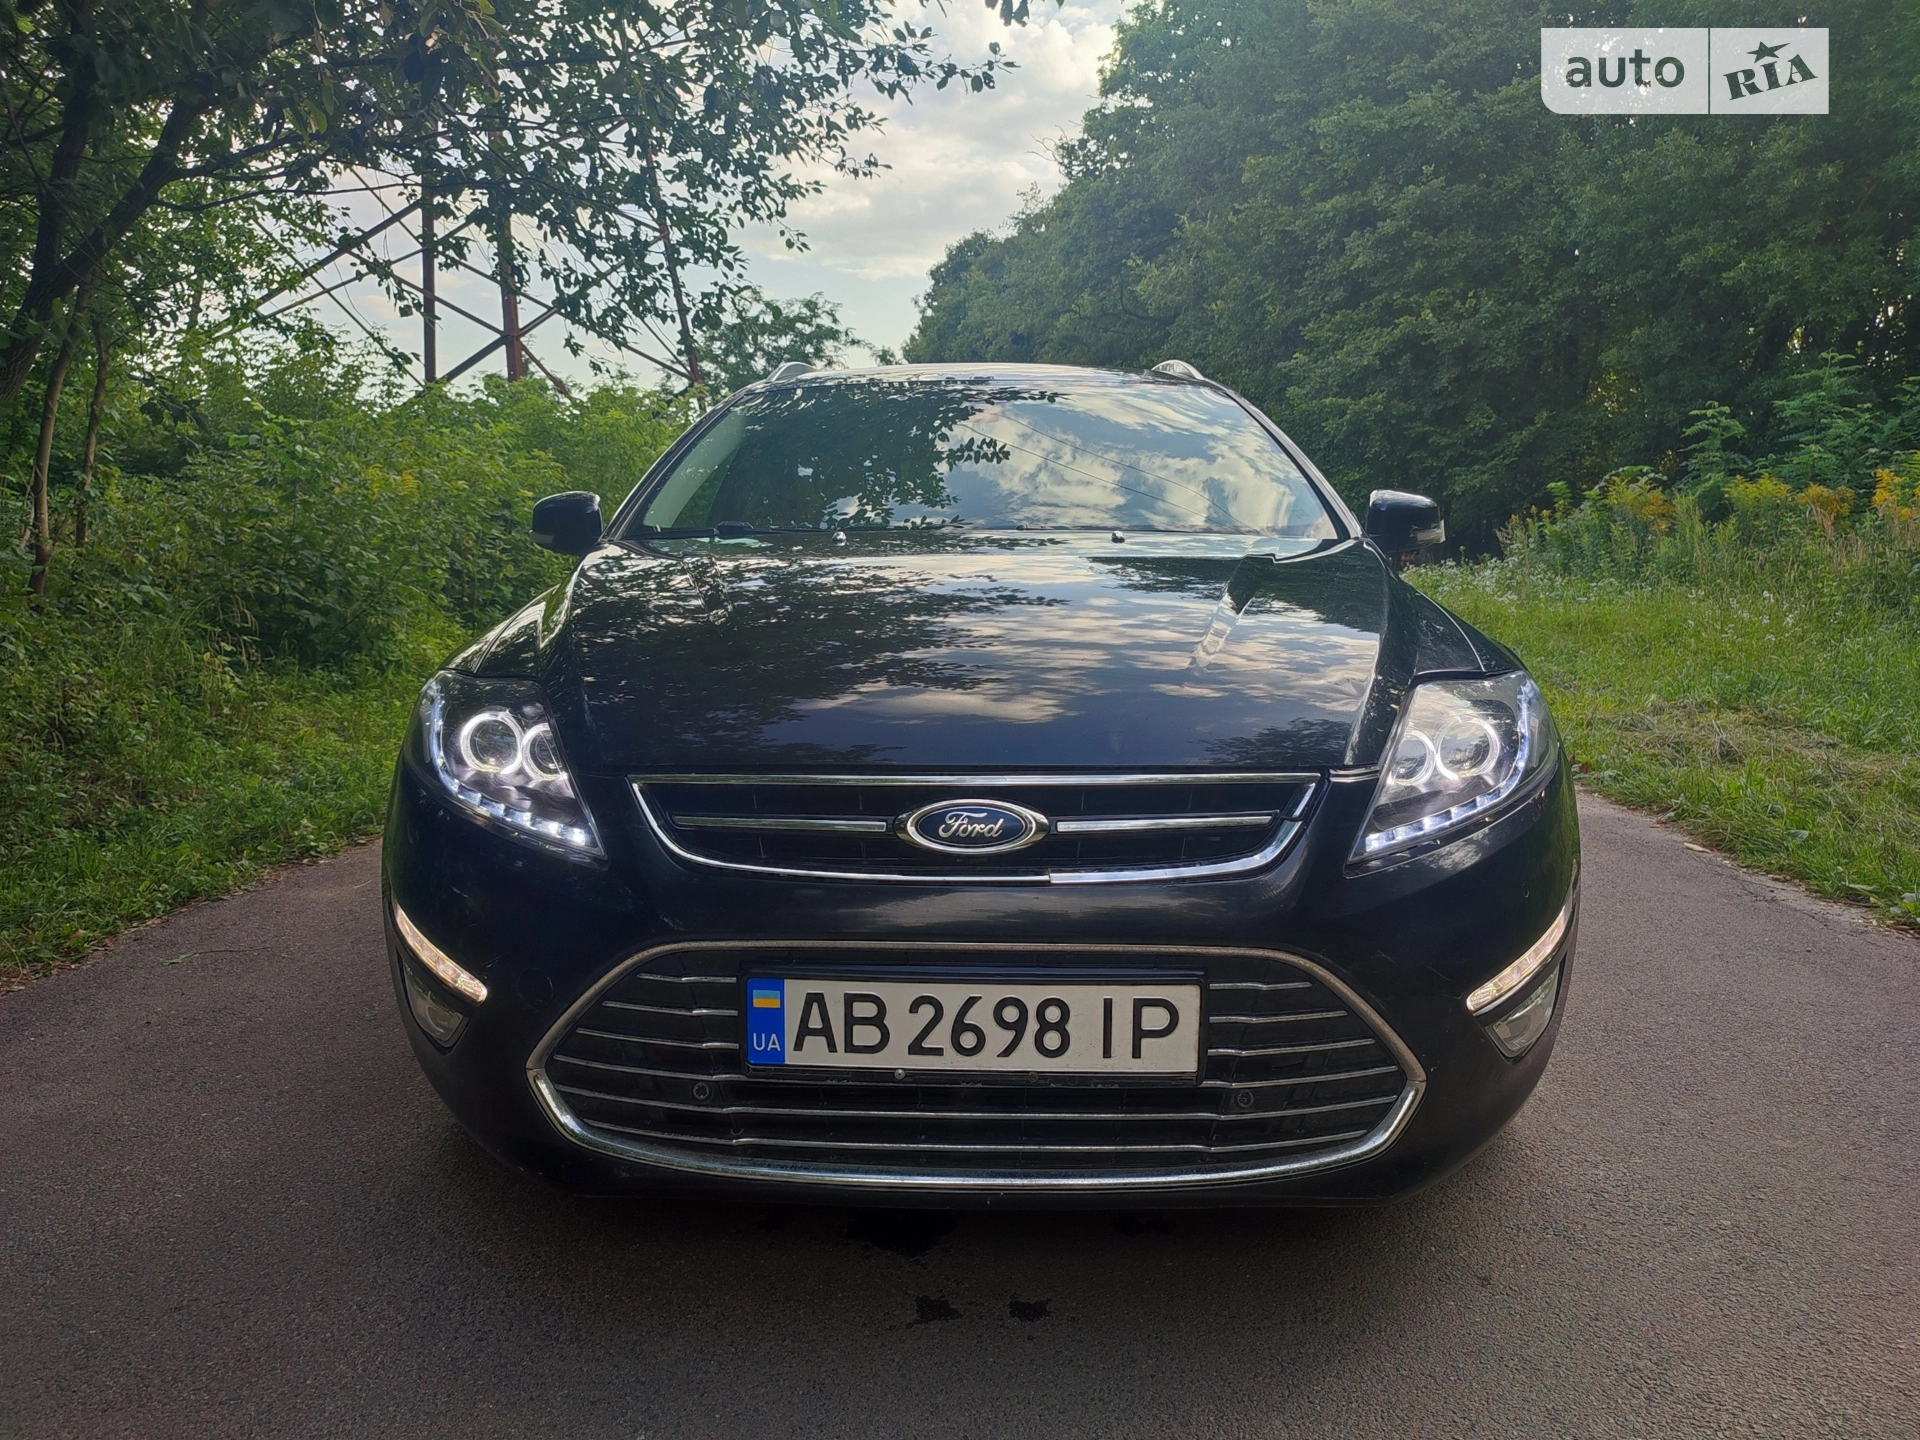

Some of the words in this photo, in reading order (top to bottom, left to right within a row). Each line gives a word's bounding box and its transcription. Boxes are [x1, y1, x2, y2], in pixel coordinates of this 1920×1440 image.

[938, 811, 1004, 838] Ford
[793, 991, 890, 1054] AB
[907, 994, 1071, 1059] 2698
[1102, 996, 1180, 1060] IP
[752, 1032, 781, 1052] UA
